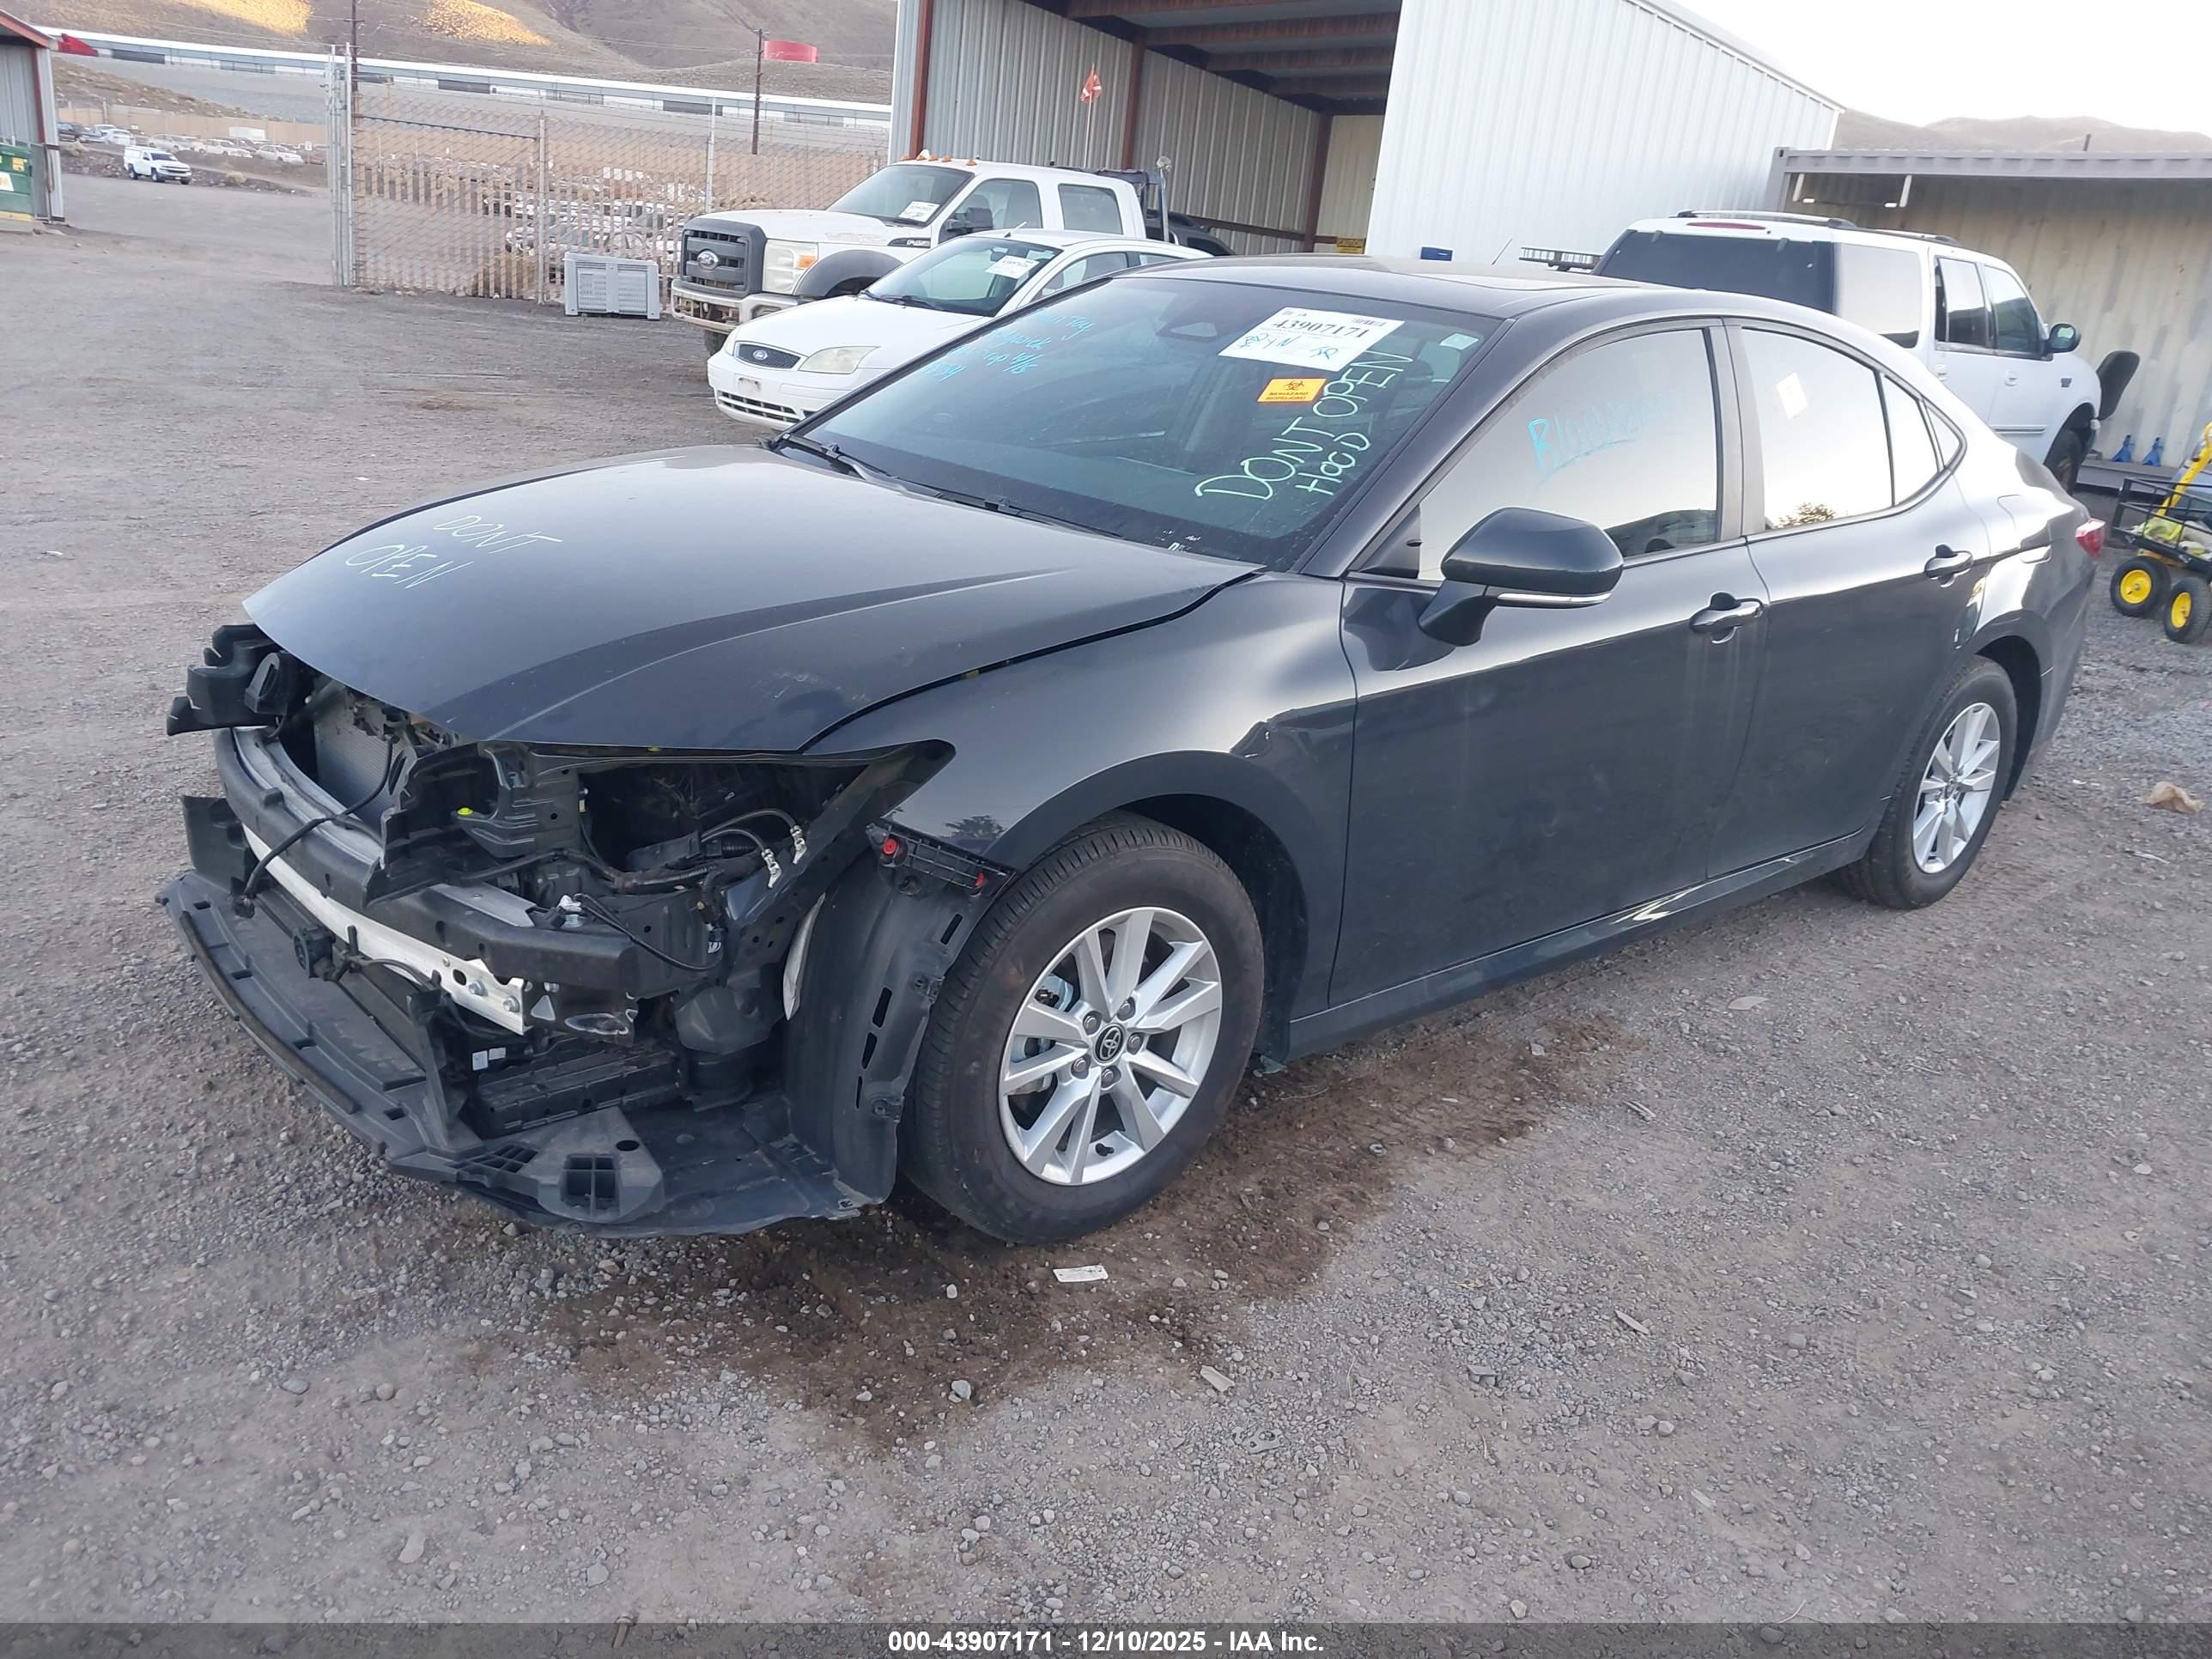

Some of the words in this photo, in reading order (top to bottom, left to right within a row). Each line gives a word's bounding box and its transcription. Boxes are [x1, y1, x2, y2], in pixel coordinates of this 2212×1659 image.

[1273, 319, 1371, 338] 43907171
[1194, 416, 1336, 500] DONT
[1312, 349, 1414, 418] OPEN
[432, 514, 564, 555] DONT
[345, 544, 474, 589] OPEN
